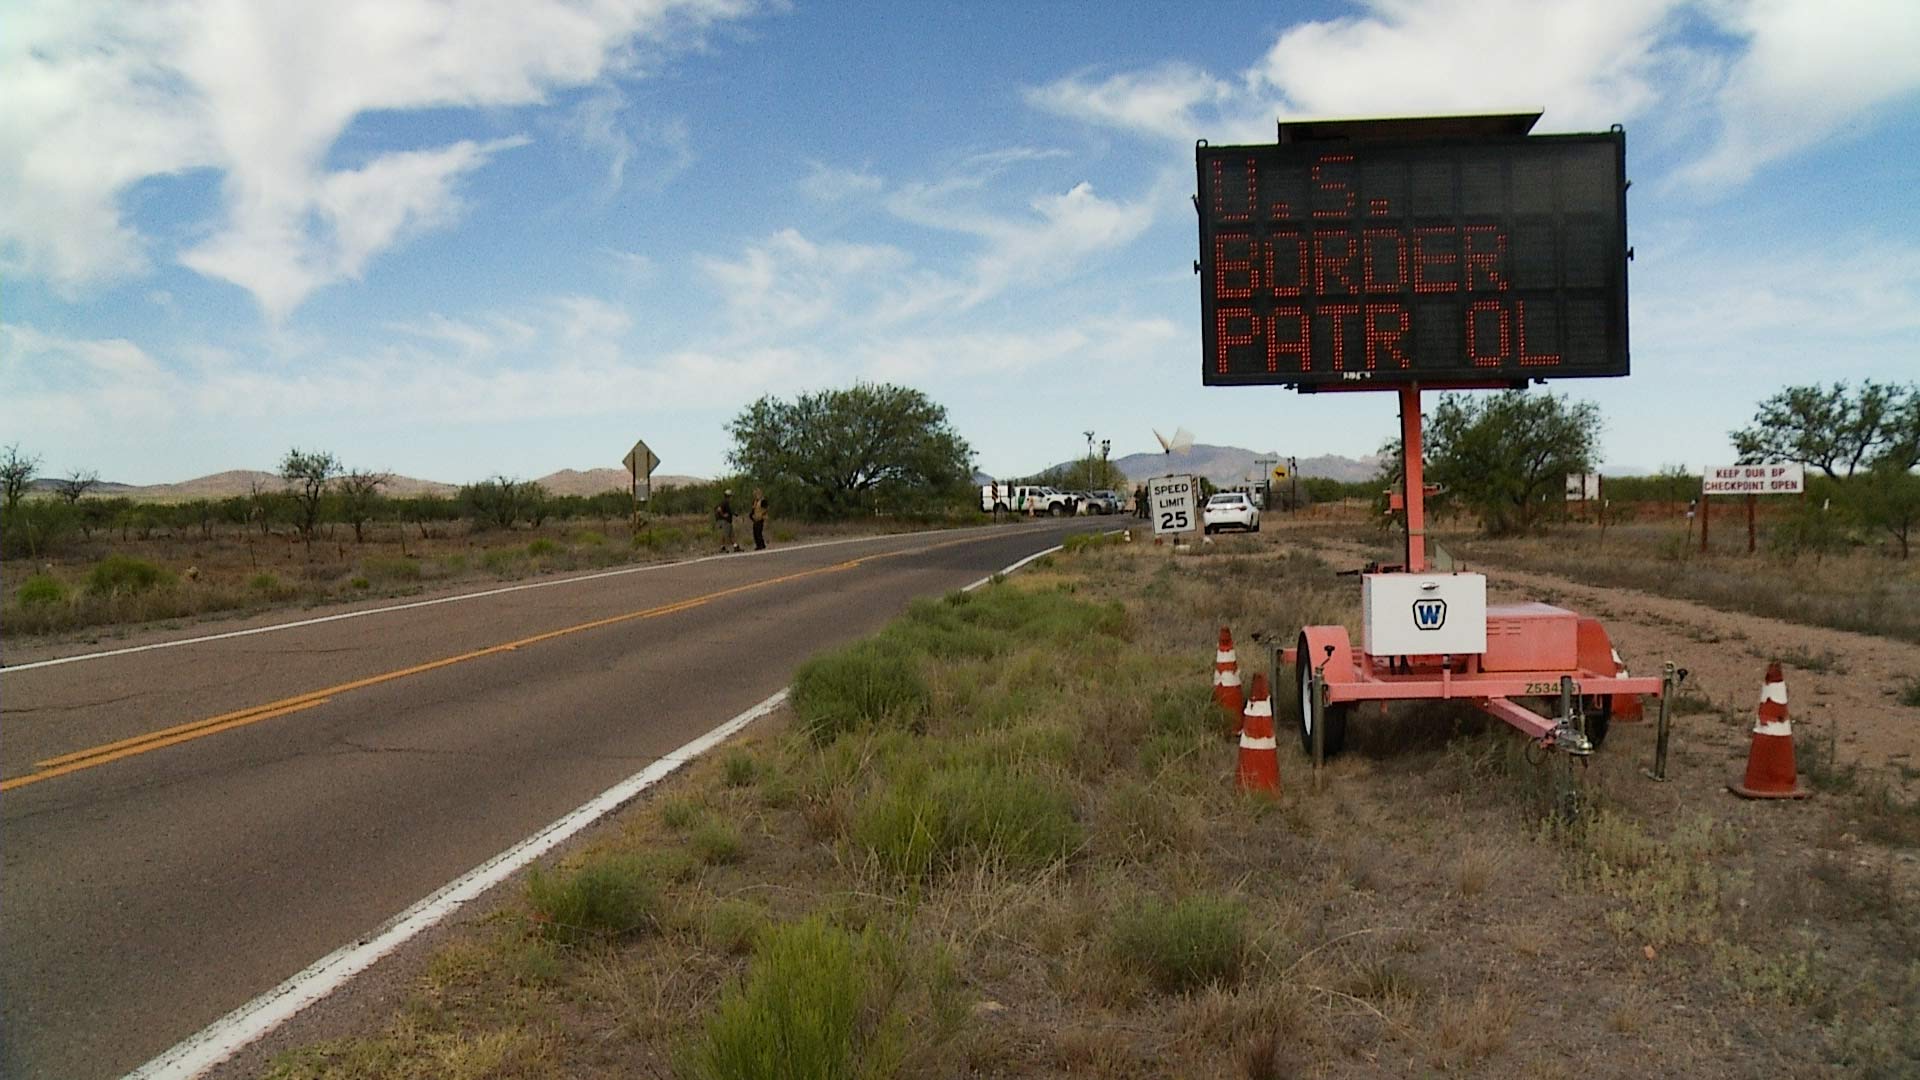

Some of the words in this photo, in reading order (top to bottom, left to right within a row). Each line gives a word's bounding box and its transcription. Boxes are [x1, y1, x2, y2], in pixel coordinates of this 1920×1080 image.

[1212, 154, 1390, 222] U.S.
[1215, 225, 1508, 299] BORDER
[1716, 469, 1740, 478] KEEP
[1745, 468, 1765, 478] OUR
[1771, 468, 1786, 477] BP
[1154, 484, 1188, 495] SPEED
[1704, 481, 1764, 491] CHECKPOINT
[1771, 480, 1798, 490] OPEN
[1160, 498, 1184, 508] LIMIT
[1161, 511, 1188, 530] 25
[1418, 605, 1441, 624] W
